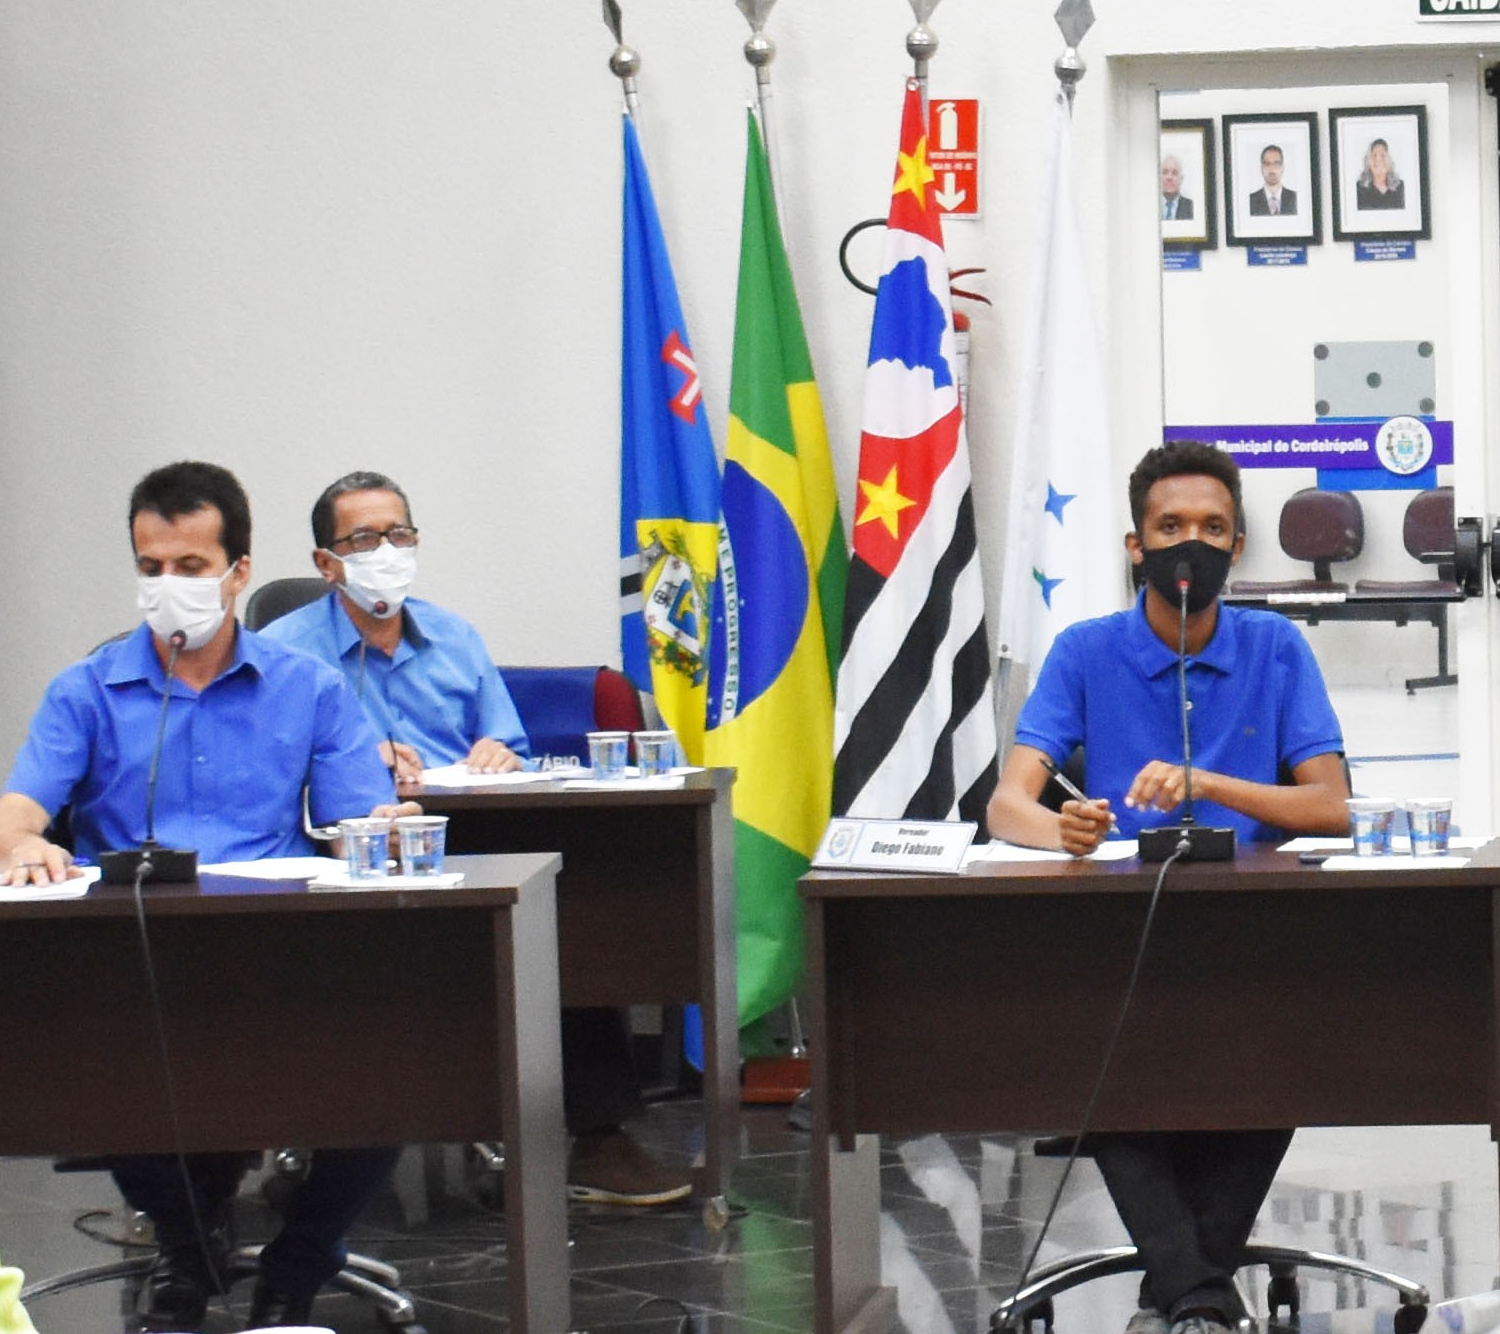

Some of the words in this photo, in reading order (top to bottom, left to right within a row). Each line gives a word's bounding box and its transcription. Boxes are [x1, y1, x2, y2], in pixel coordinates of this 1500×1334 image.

[1216, 440, 1272, 455] Municipal
[1274, 440, 1289, 452] de
[1291, 438, 1368, 454] Cordeirópolis
[898, 828, 930, 836] Vereador
[871, 841, 901, 855] Diego
[902, 842, 944, 856] Fabiano
